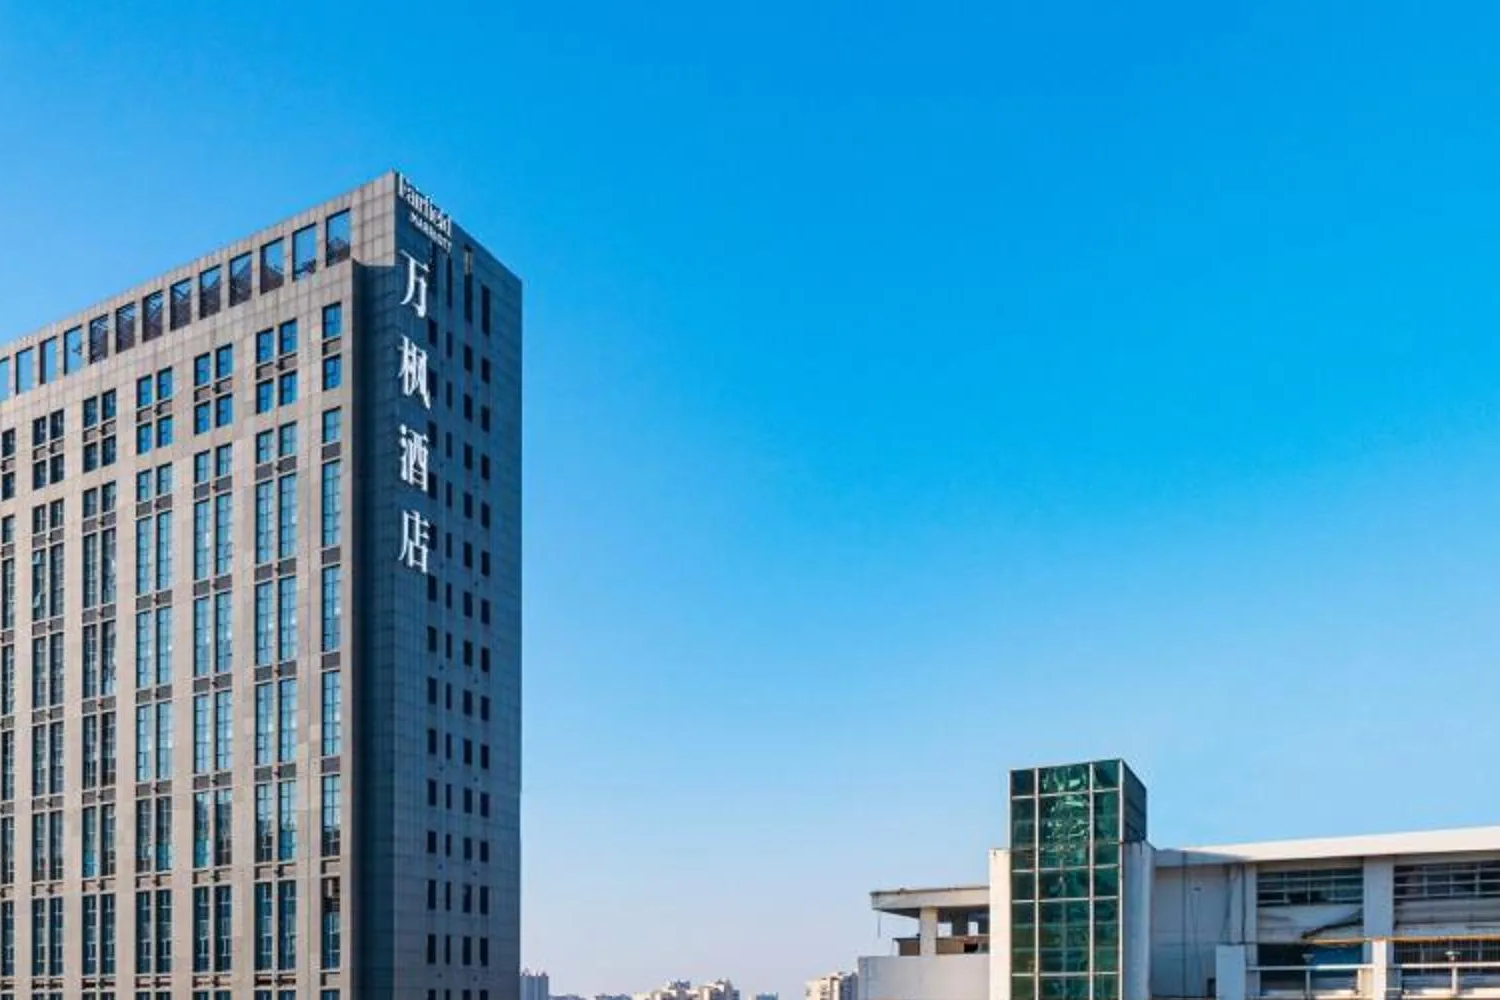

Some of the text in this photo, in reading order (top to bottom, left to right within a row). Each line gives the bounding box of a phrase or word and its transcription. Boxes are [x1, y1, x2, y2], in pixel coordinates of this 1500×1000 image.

[399, 172, 452, 238] Fairfield
[399, 250, 431, 573] 万枫酒店
